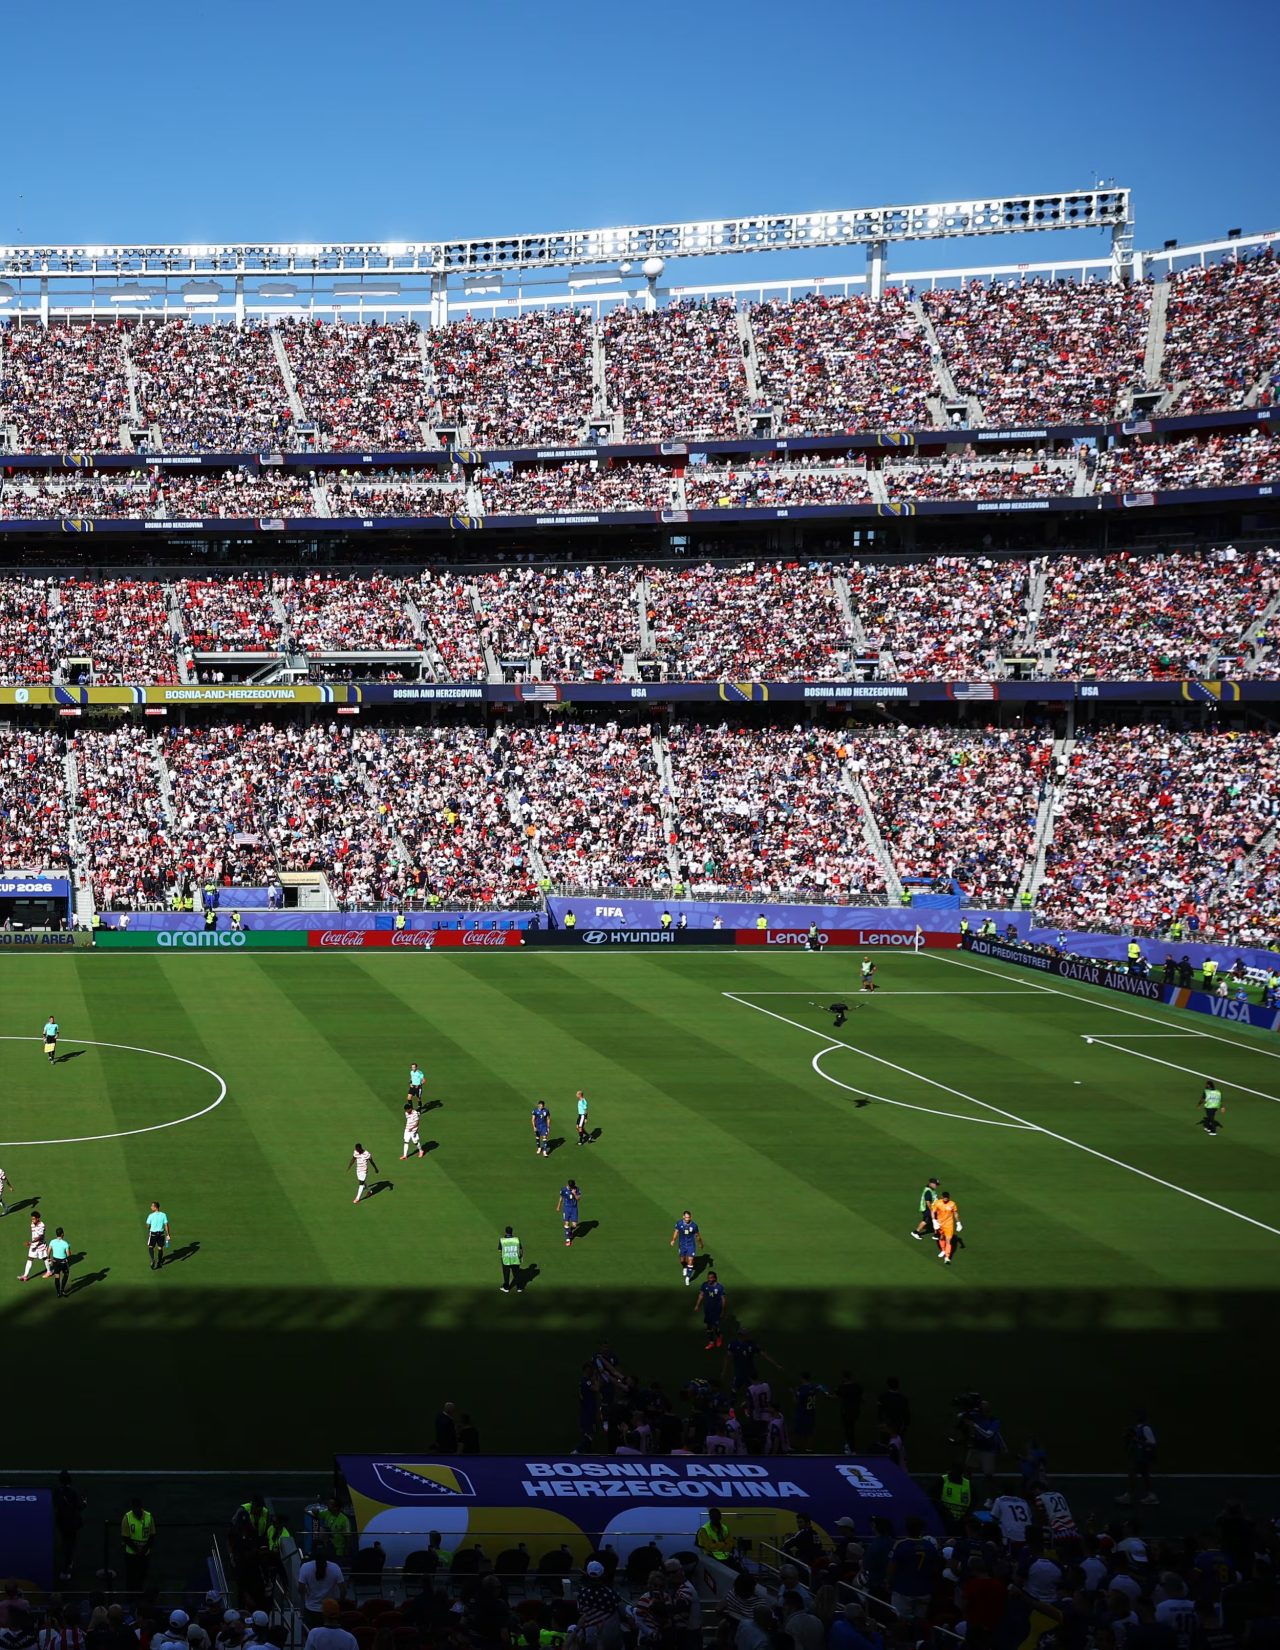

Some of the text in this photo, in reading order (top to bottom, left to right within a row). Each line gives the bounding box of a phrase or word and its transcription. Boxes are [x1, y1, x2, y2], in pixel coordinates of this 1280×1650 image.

[978, 432, 999, 440] BOSNIA
[1011, 430, 1047, 439] HERZEGOVINA
[1012, 501, 1049, 510] HERZEGOVINA
[16, 689, 28, 702] 0
[166, 690, 294, 699] BOSNIA-AND-HERZEGOVINA
[393, 689, 482, 698] BOSNIA AND HERZEGOVINA
[632, 689, 646, 697] USA
[804, 687, 908, 697] BOSNIA AND HERZEGOVINA
[1082, 686, 1098, 696] USA
[17, 884, 53, 892] 2026
[596, 908, 623, 917] FIFA
[14, 934, 39, 945] BAY
[42, 934, 74, 945] AREA
[157, 931, 246, 946] aramco
[611, 932, 674, 942] HYUNDAI
[767, 931, 828, 944] Lenoo
[860, 931, 925, 944] Lenovo
[971, 940, 1051, 969] ADI PREDICTSTREET
[1059, 961, 1159, 999] QATAR AIRWAYS
[1207, 995, 1251, 1024] VISA
[525, 1464, 768, 1477] BOSNIA AND
[522, 1480, 810, 1497] HERZEGOVINA
[1050, 1496, 1066, 1512] 20
[1008, 1505, 1027, 1522] 13
[916, 1551, 926, 1569] 7
